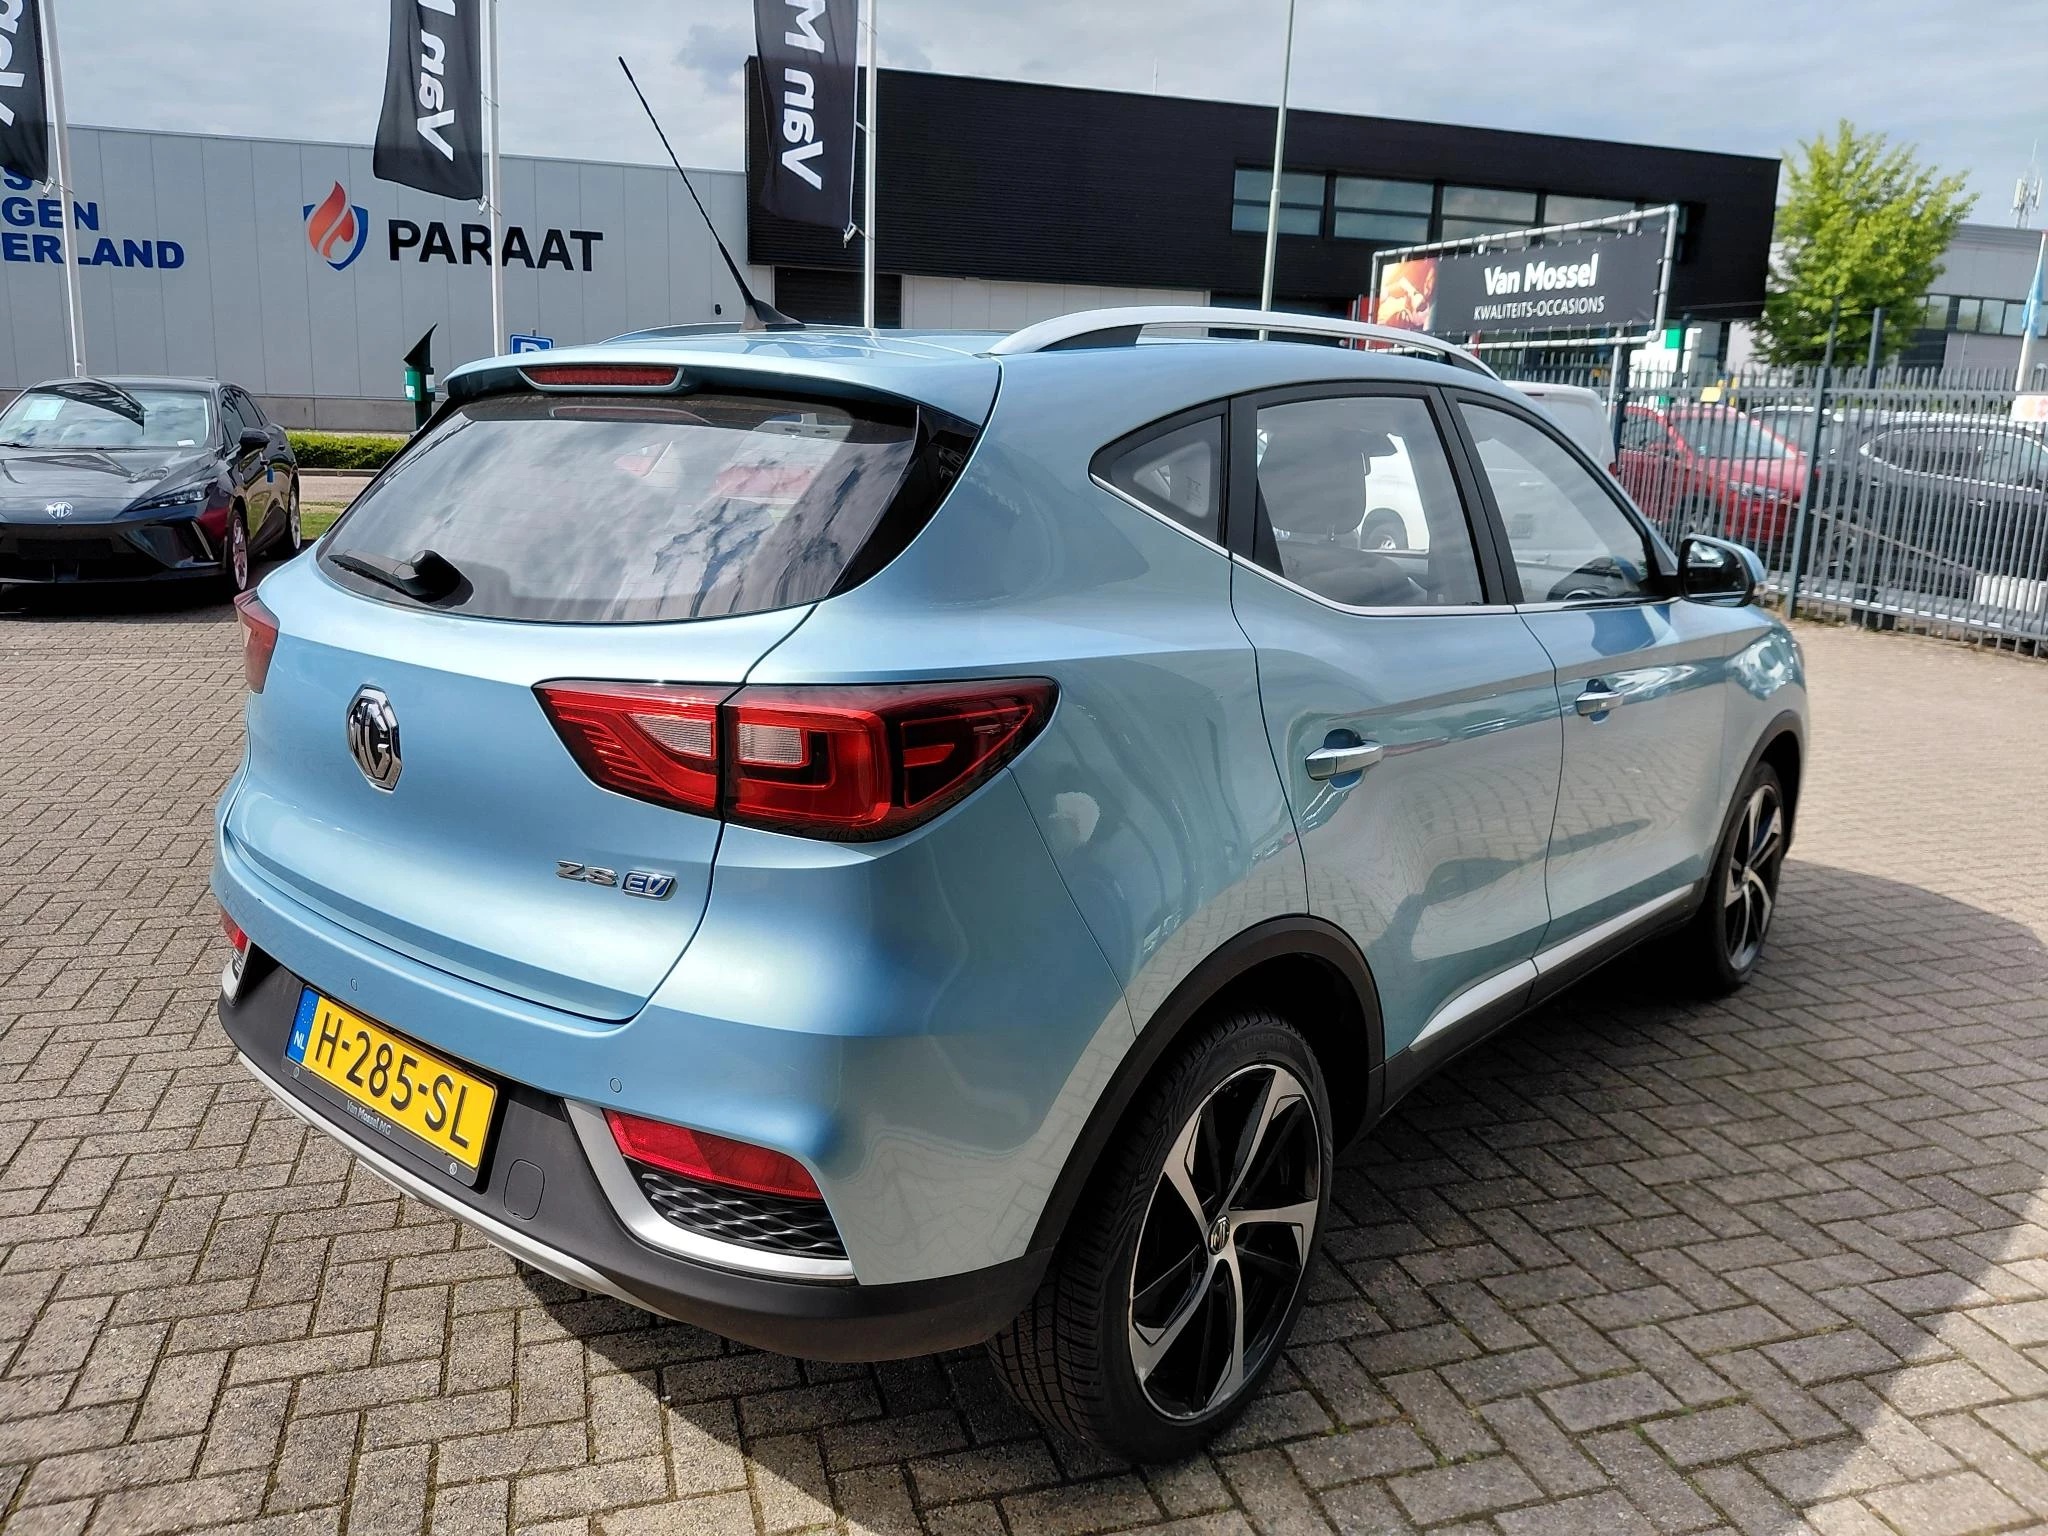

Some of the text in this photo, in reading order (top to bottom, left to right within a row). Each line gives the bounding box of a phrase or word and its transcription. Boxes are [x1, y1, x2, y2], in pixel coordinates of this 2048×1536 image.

[388, 219, 604, 272] PARAAT
[1484, 252, 1600, 296] Van Mossel
[1473, 295, 1606, 321] KWALITEITS-OCCASIONS
[555, 860, 670, 896] ZS EV
[293, 1030, 305, 1051] NL
[314, 1010, 470, 1149] H-285-SL
[346, 1099, 392, 1136] Van Mossel MG
